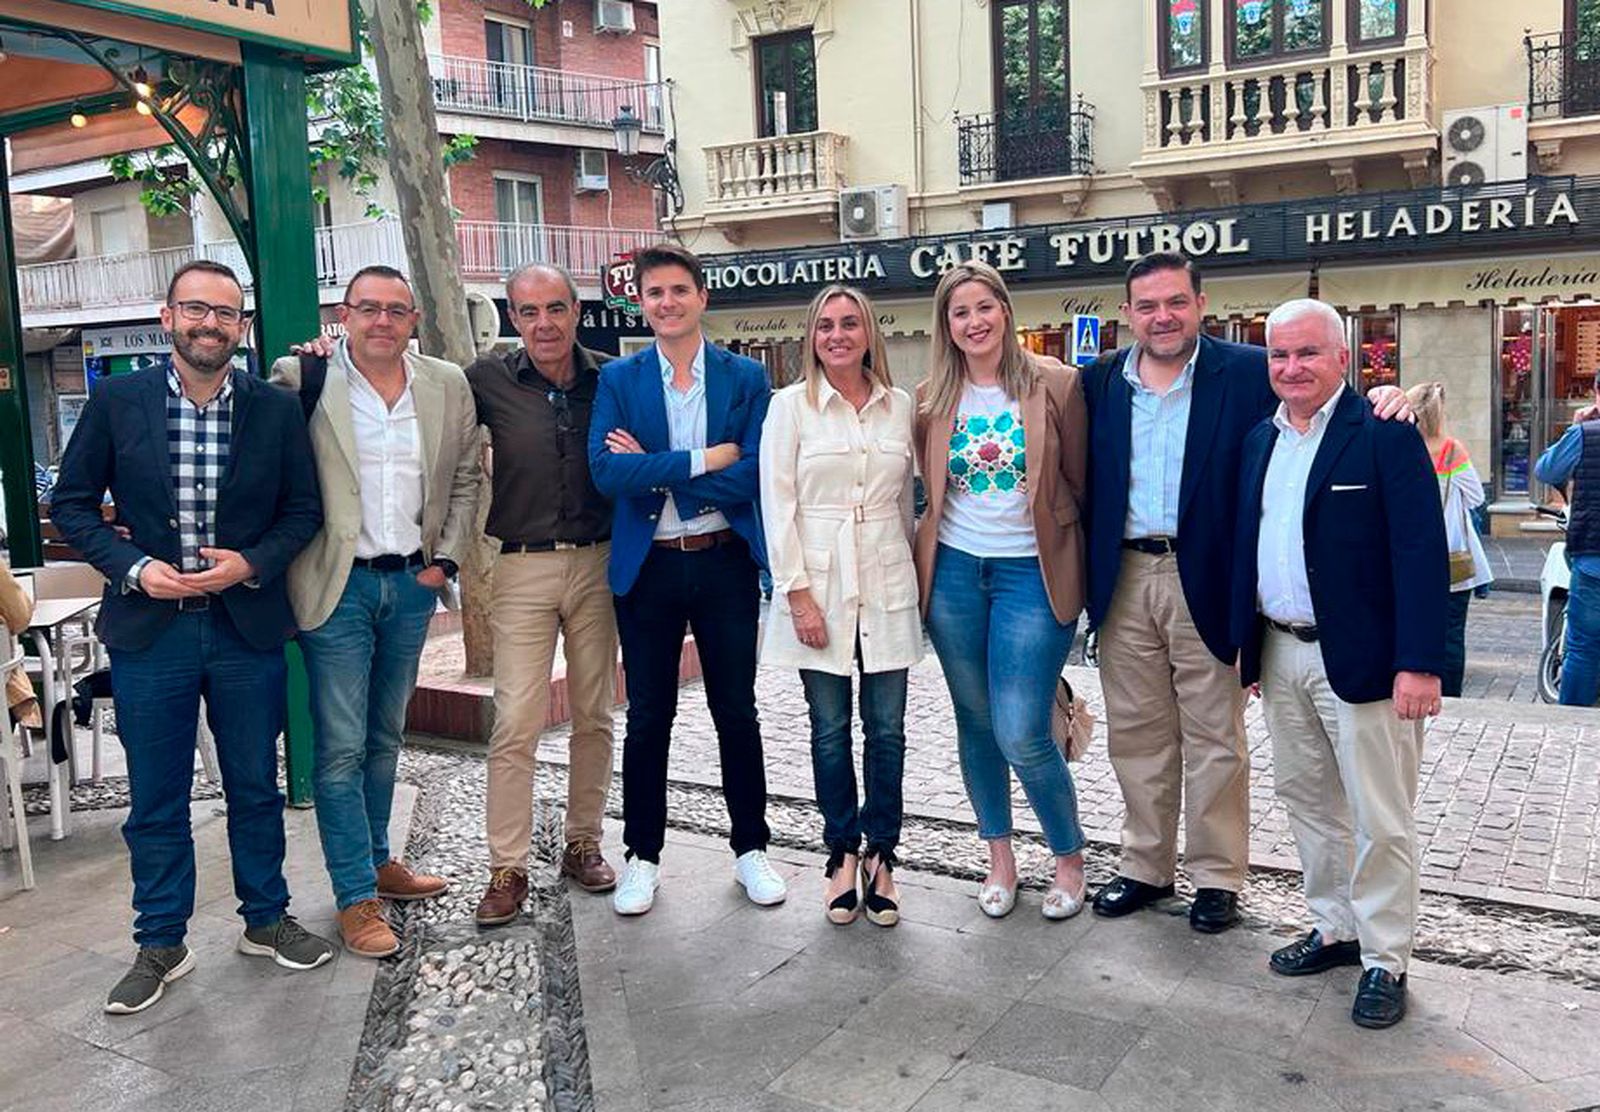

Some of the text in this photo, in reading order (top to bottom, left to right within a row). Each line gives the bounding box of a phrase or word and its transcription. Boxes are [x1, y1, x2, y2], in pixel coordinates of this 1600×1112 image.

[1305, 189, 1580, 243] HELADERÍA
[700, 218, 1250, 289] HOCOLATERÍA CAFÉ FÚTBOL
[124, 334, 144, 348] LOS
